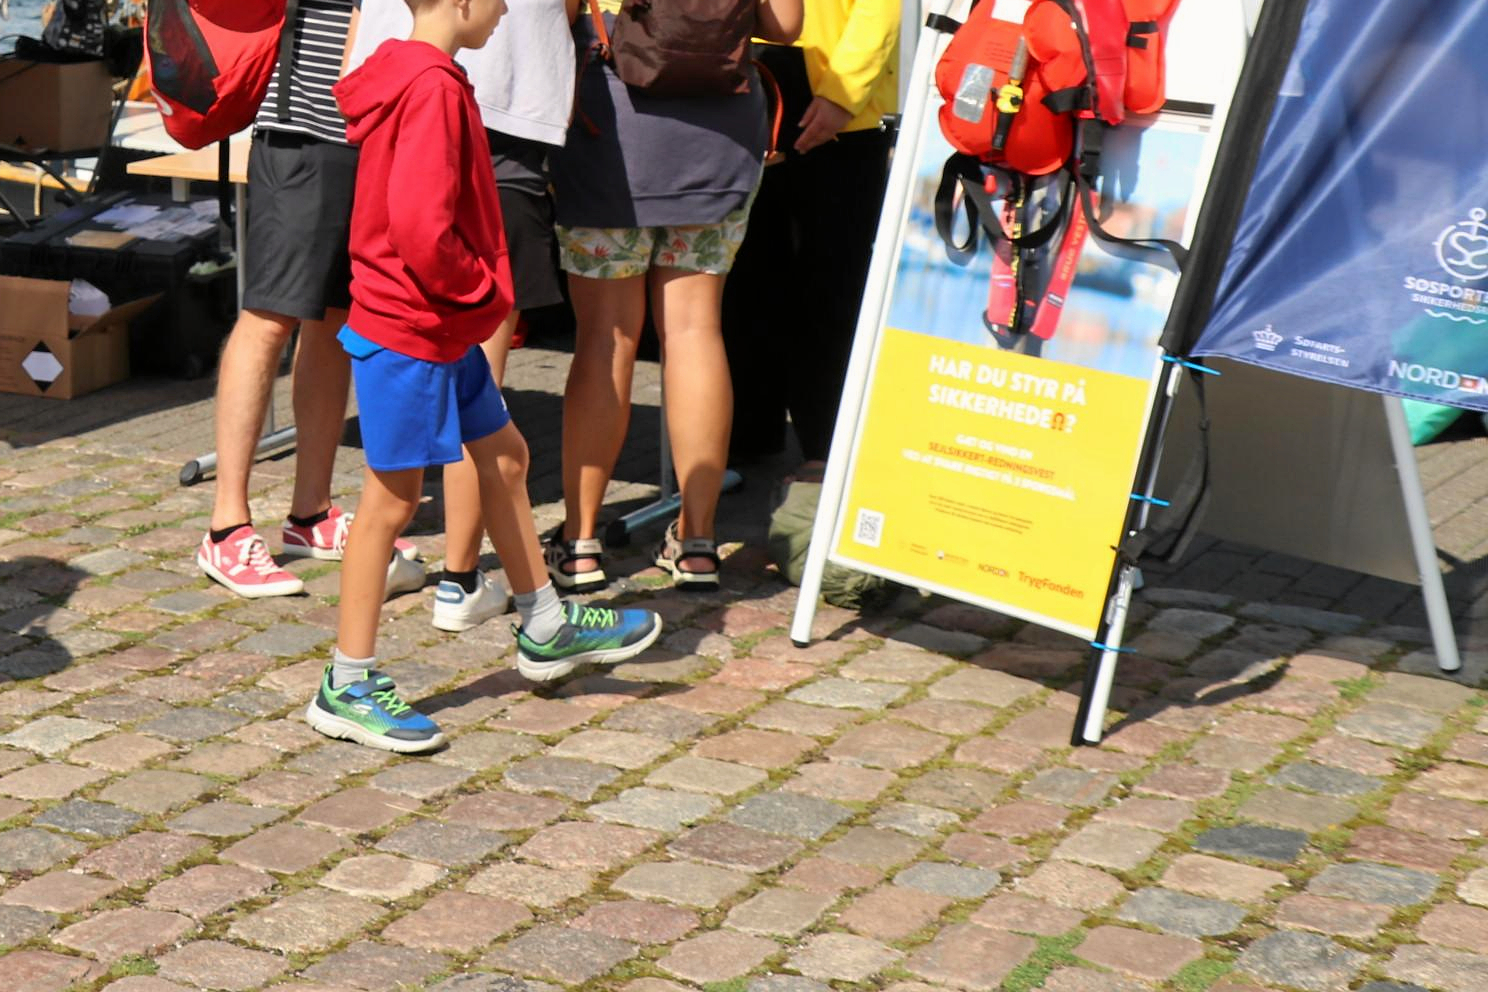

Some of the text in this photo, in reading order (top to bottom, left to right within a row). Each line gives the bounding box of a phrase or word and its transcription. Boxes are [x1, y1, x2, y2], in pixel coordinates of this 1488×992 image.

[928, 354, 1087, 406] HAR DU STYR PÅ
[1018, 570, 1084, 600] TrygFonden
